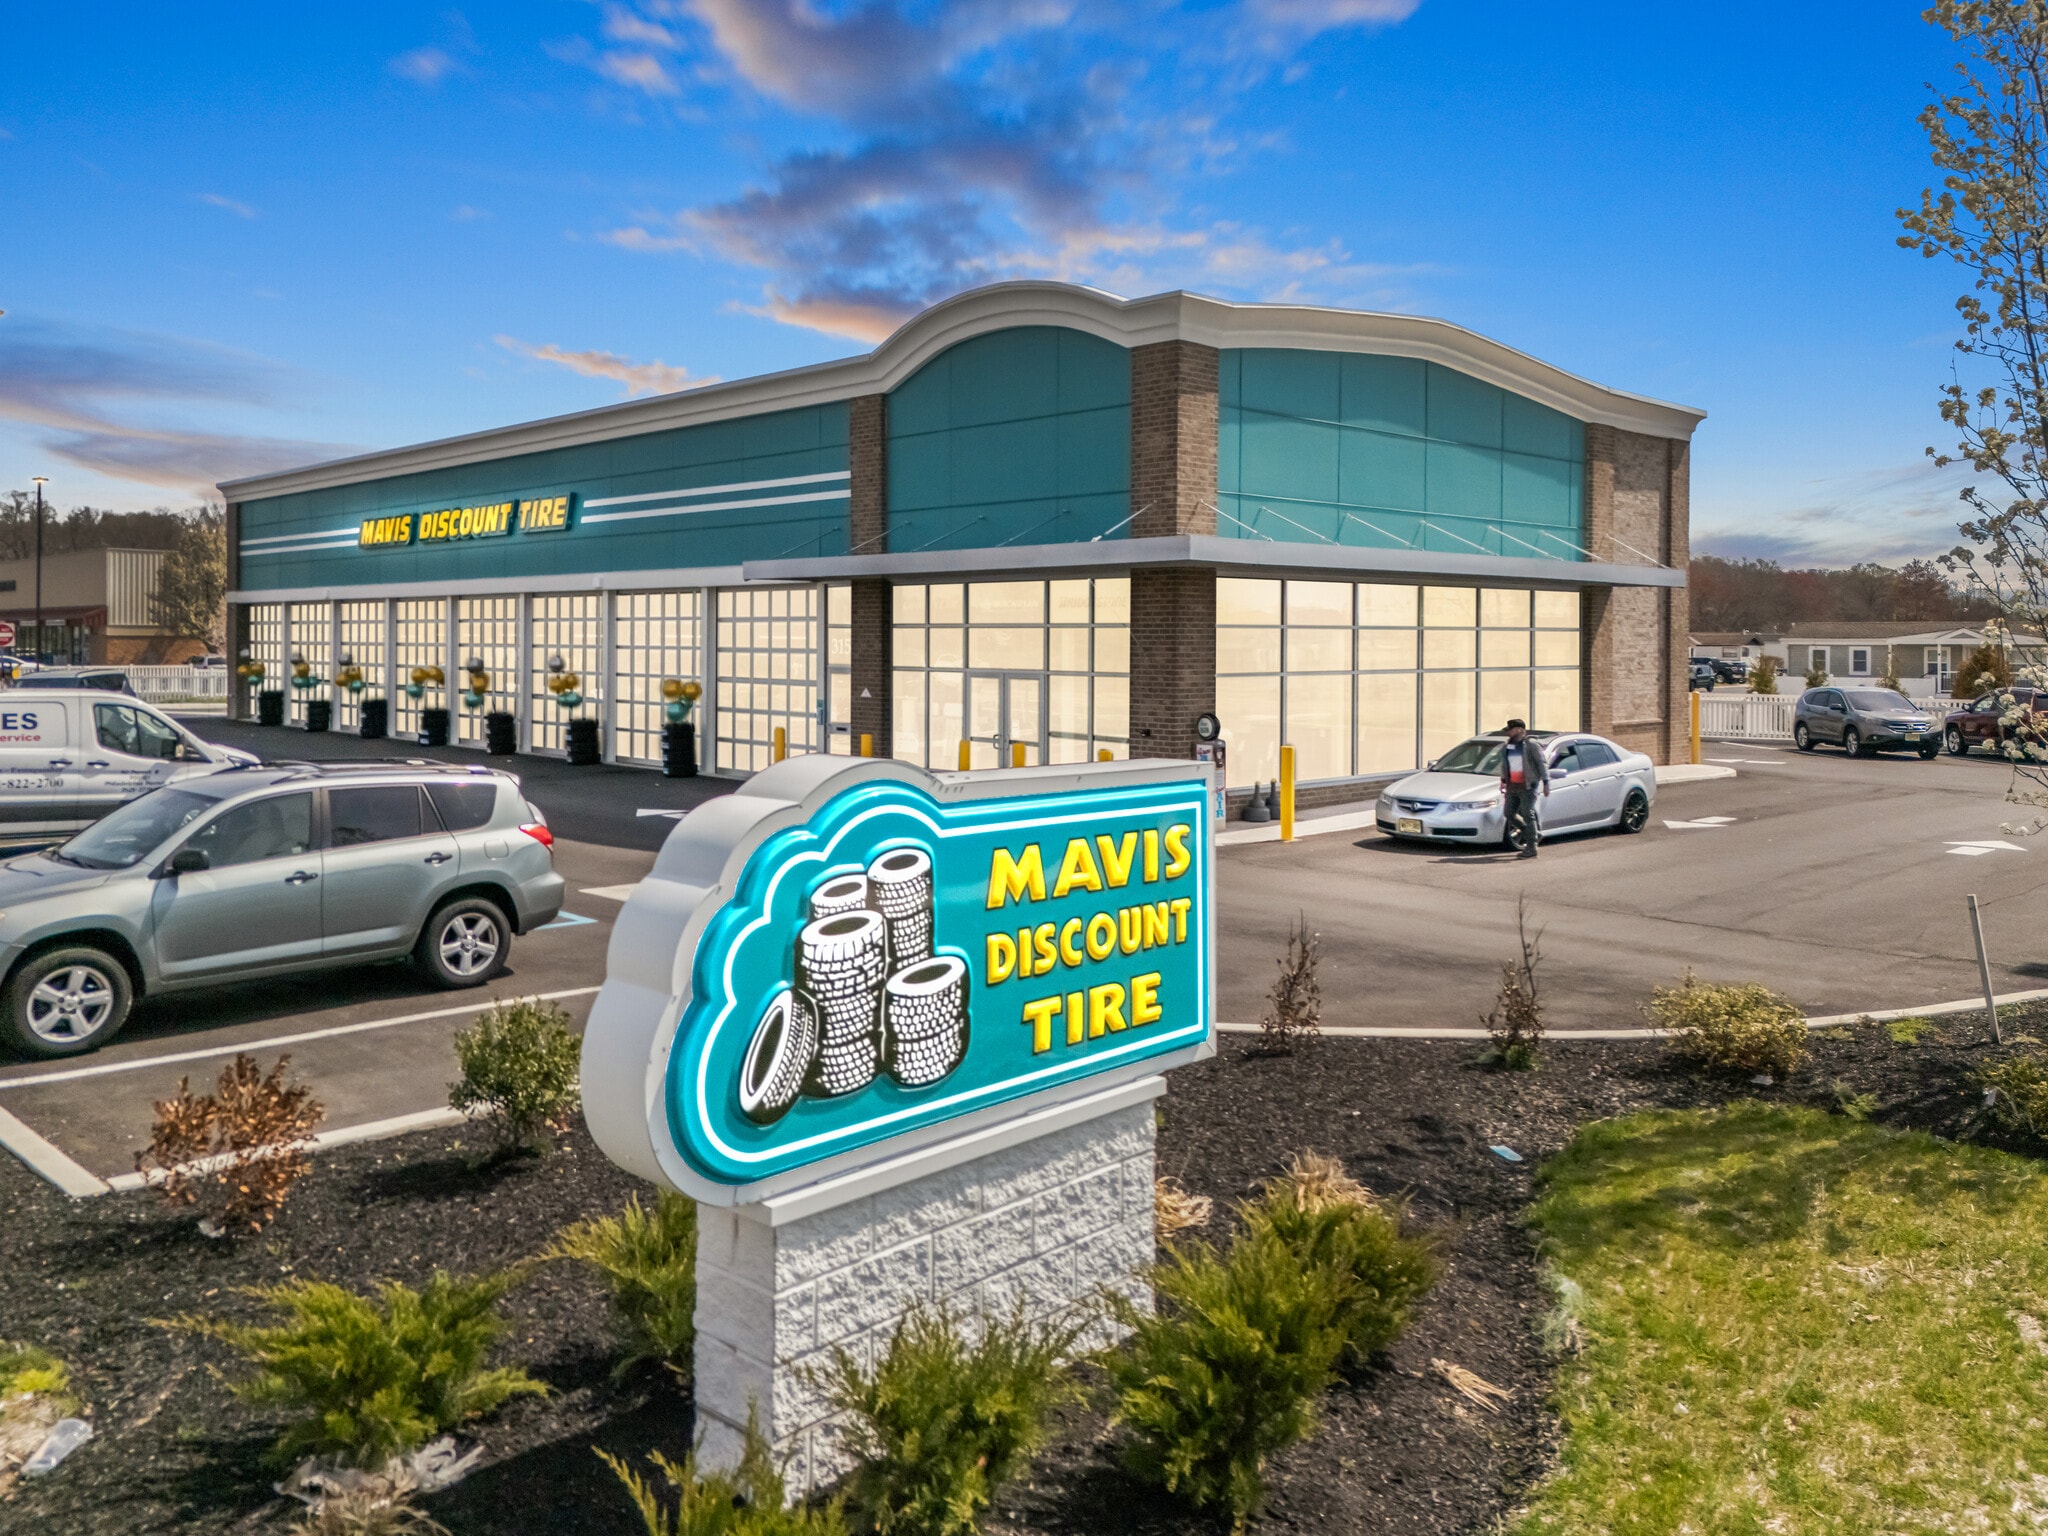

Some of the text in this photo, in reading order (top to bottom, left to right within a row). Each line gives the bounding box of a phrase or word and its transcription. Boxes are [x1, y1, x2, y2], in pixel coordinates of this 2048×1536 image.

[360, 497, 567, 545] MAVIS DISCOUNT TIRE
[0, 778, 64, 789] -822-2700
[985, 824, 1191, 910] MAVIS
[985, 897, 1192, 987] DISCOUNT
[1021, 971, 1163, 1055] TIRE
